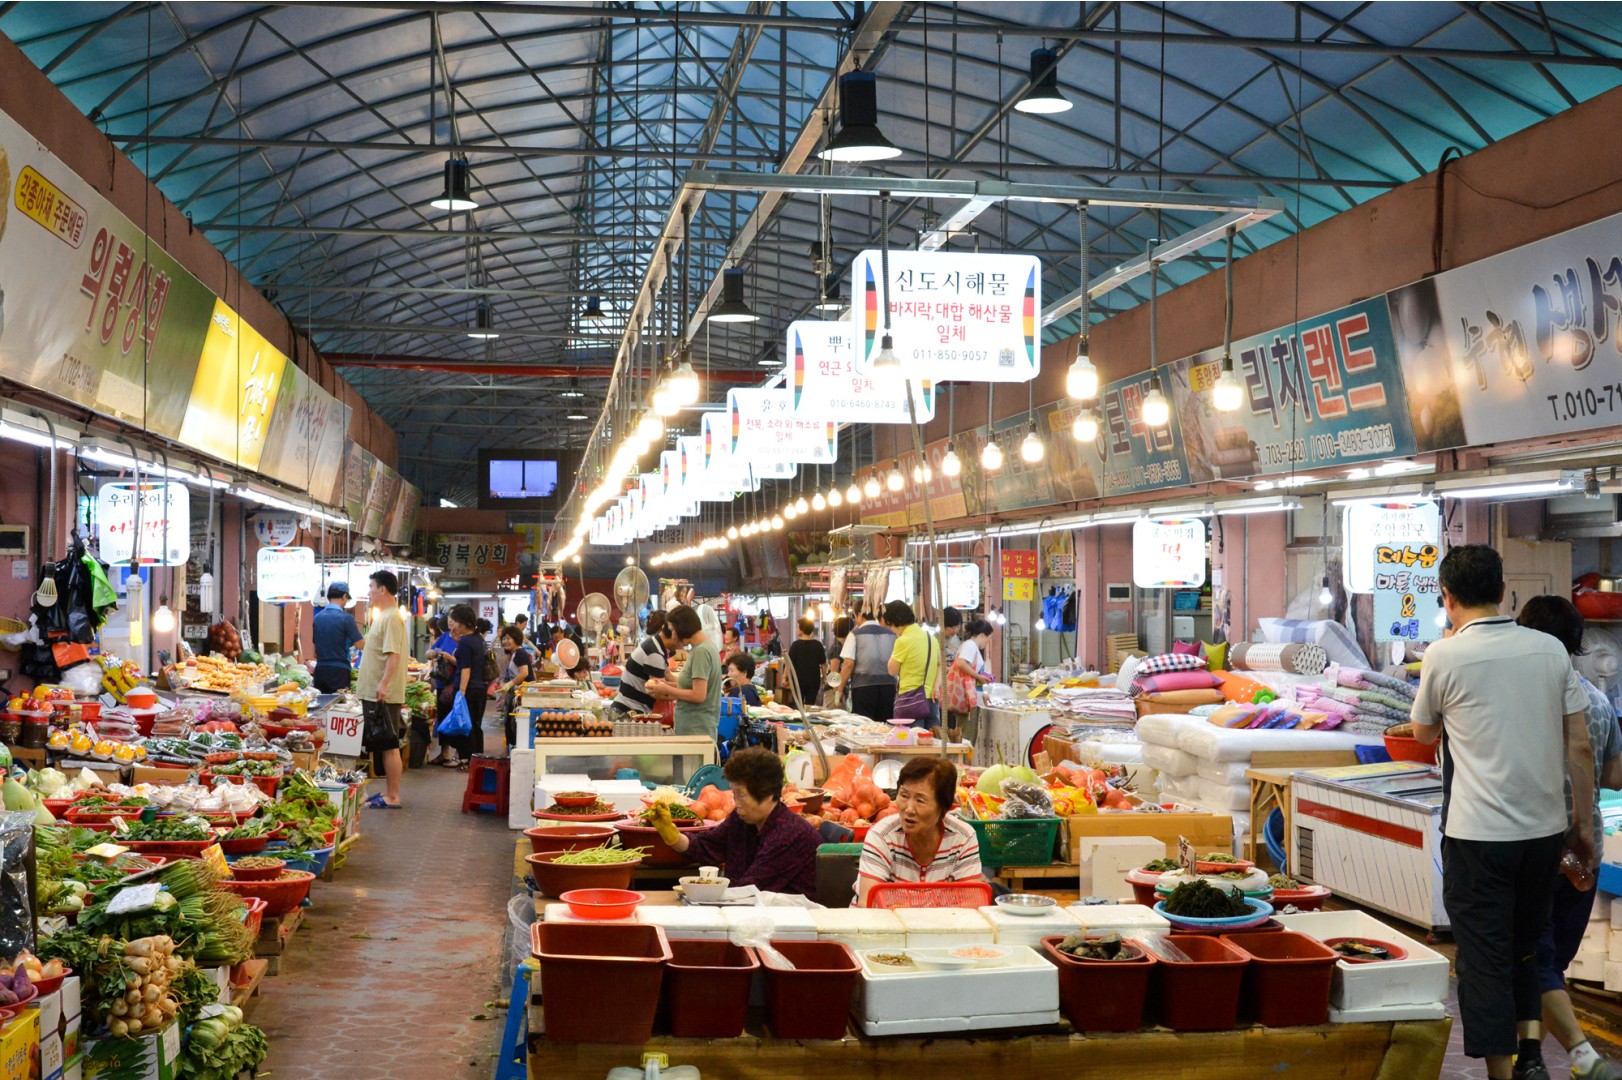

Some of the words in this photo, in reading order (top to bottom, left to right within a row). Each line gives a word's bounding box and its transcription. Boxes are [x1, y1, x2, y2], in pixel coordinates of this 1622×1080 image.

[20, 172, 55, 223] 각종야채
[52, 200, 85, 244] 주문배달
[894, 268, 1010, 296] 신도시해물
[80, 227, 171, 363] 의령상회
[888, 301, 965, 322] 바지락,대합
[968, 303, 1013, 324] 해산물
[827, 335, 851, 354] 뿌
[936, 325, 966, 344] 일체
[818, 360, 842, 376] 연근
[1240, 312, 1387, 430] 리치랜드
[766, 419, 783, 429] 소라
[776, 431, 793, 442] 일체
[437, 543, 508, 566] 경북상회
[1377, 545, 1439, 568] 제수용
[1376, 571, 1412, 594] 마른
[483, 606, 494, 617] 쌀
[1401, 593, 1416, 618] &
[1390, 619, 1420, 640] 해물
[330, 716, 359, 737] 매장
